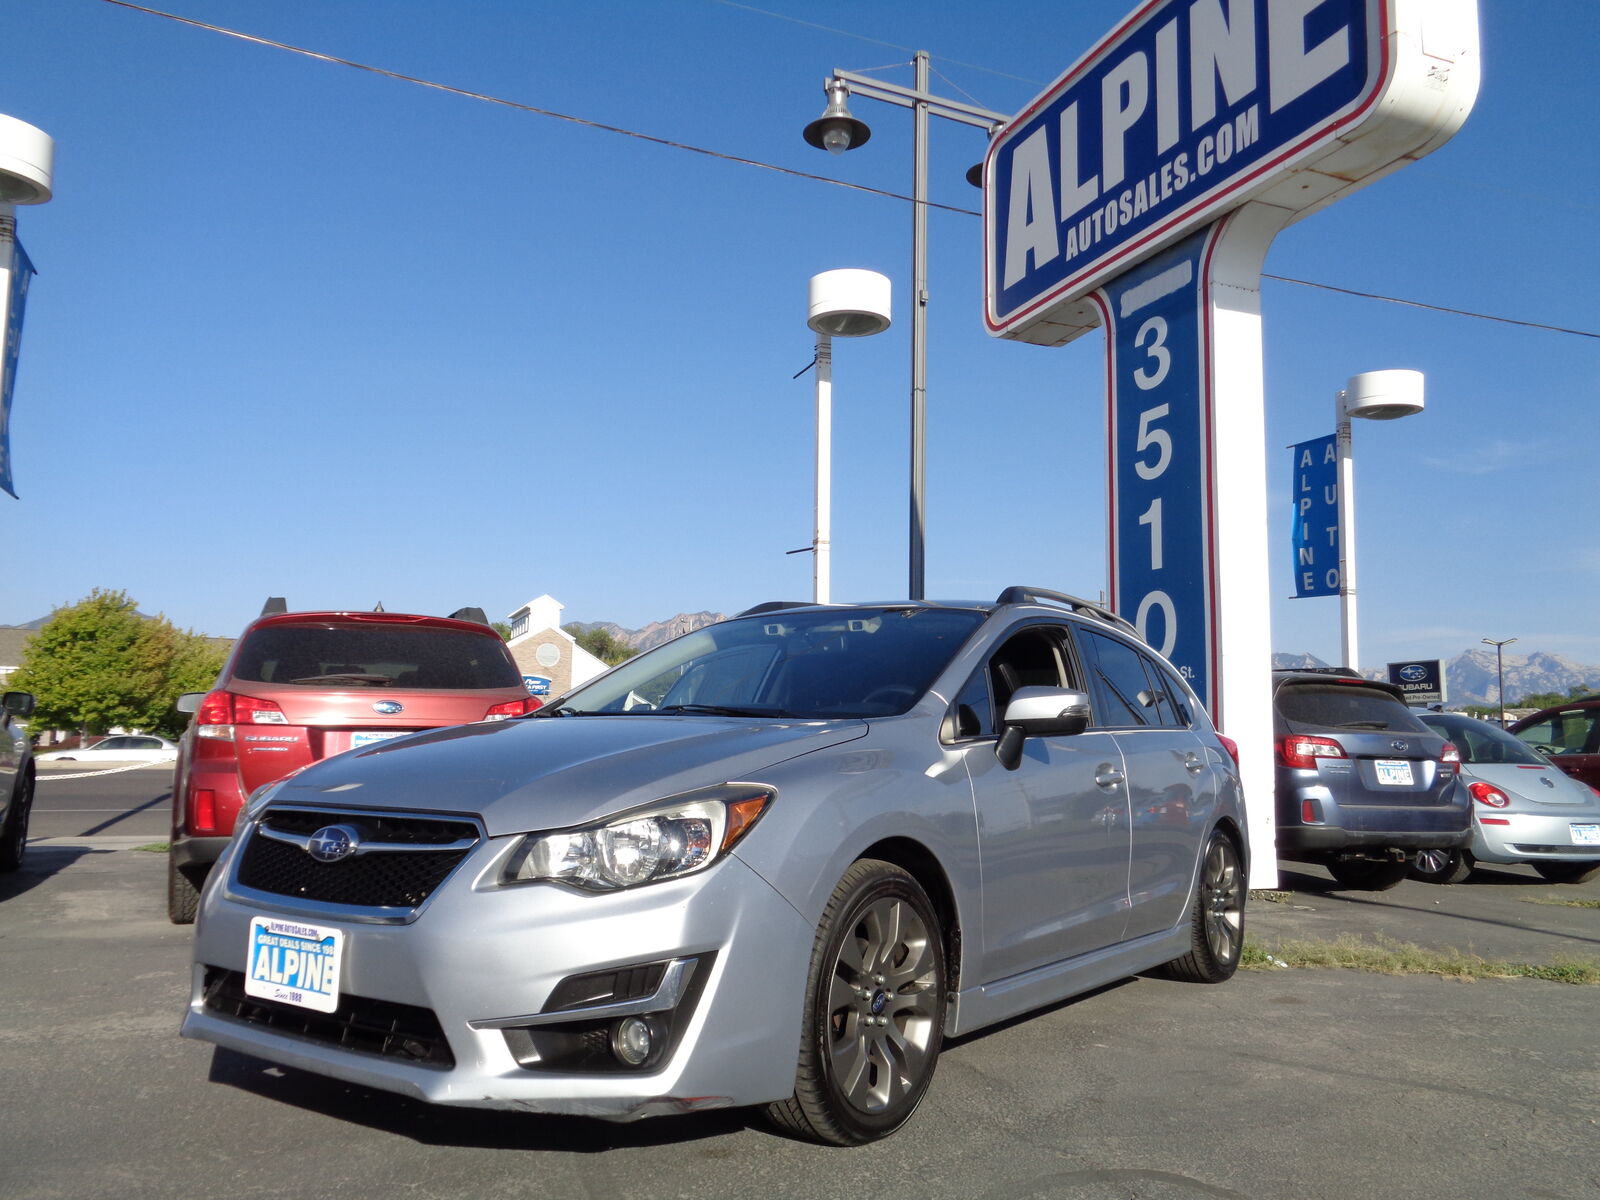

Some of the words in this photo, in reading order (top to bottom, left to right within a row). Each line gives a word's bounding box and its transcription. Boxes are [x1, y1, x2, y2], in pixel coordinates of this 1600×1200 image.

[1003, 0, 1350, 291] ALPINE
[1065, 104, 1260, 263] AUTOSALES.COM
[1299, 449, 1315, 591] ALPINE
[1323, 443, 1341, 589] AUTO
[1180, 665, 1195, 679] St.
[1400, 682, 1433, 691] UBARU
[253, 945, 334, 995] ALPINE
